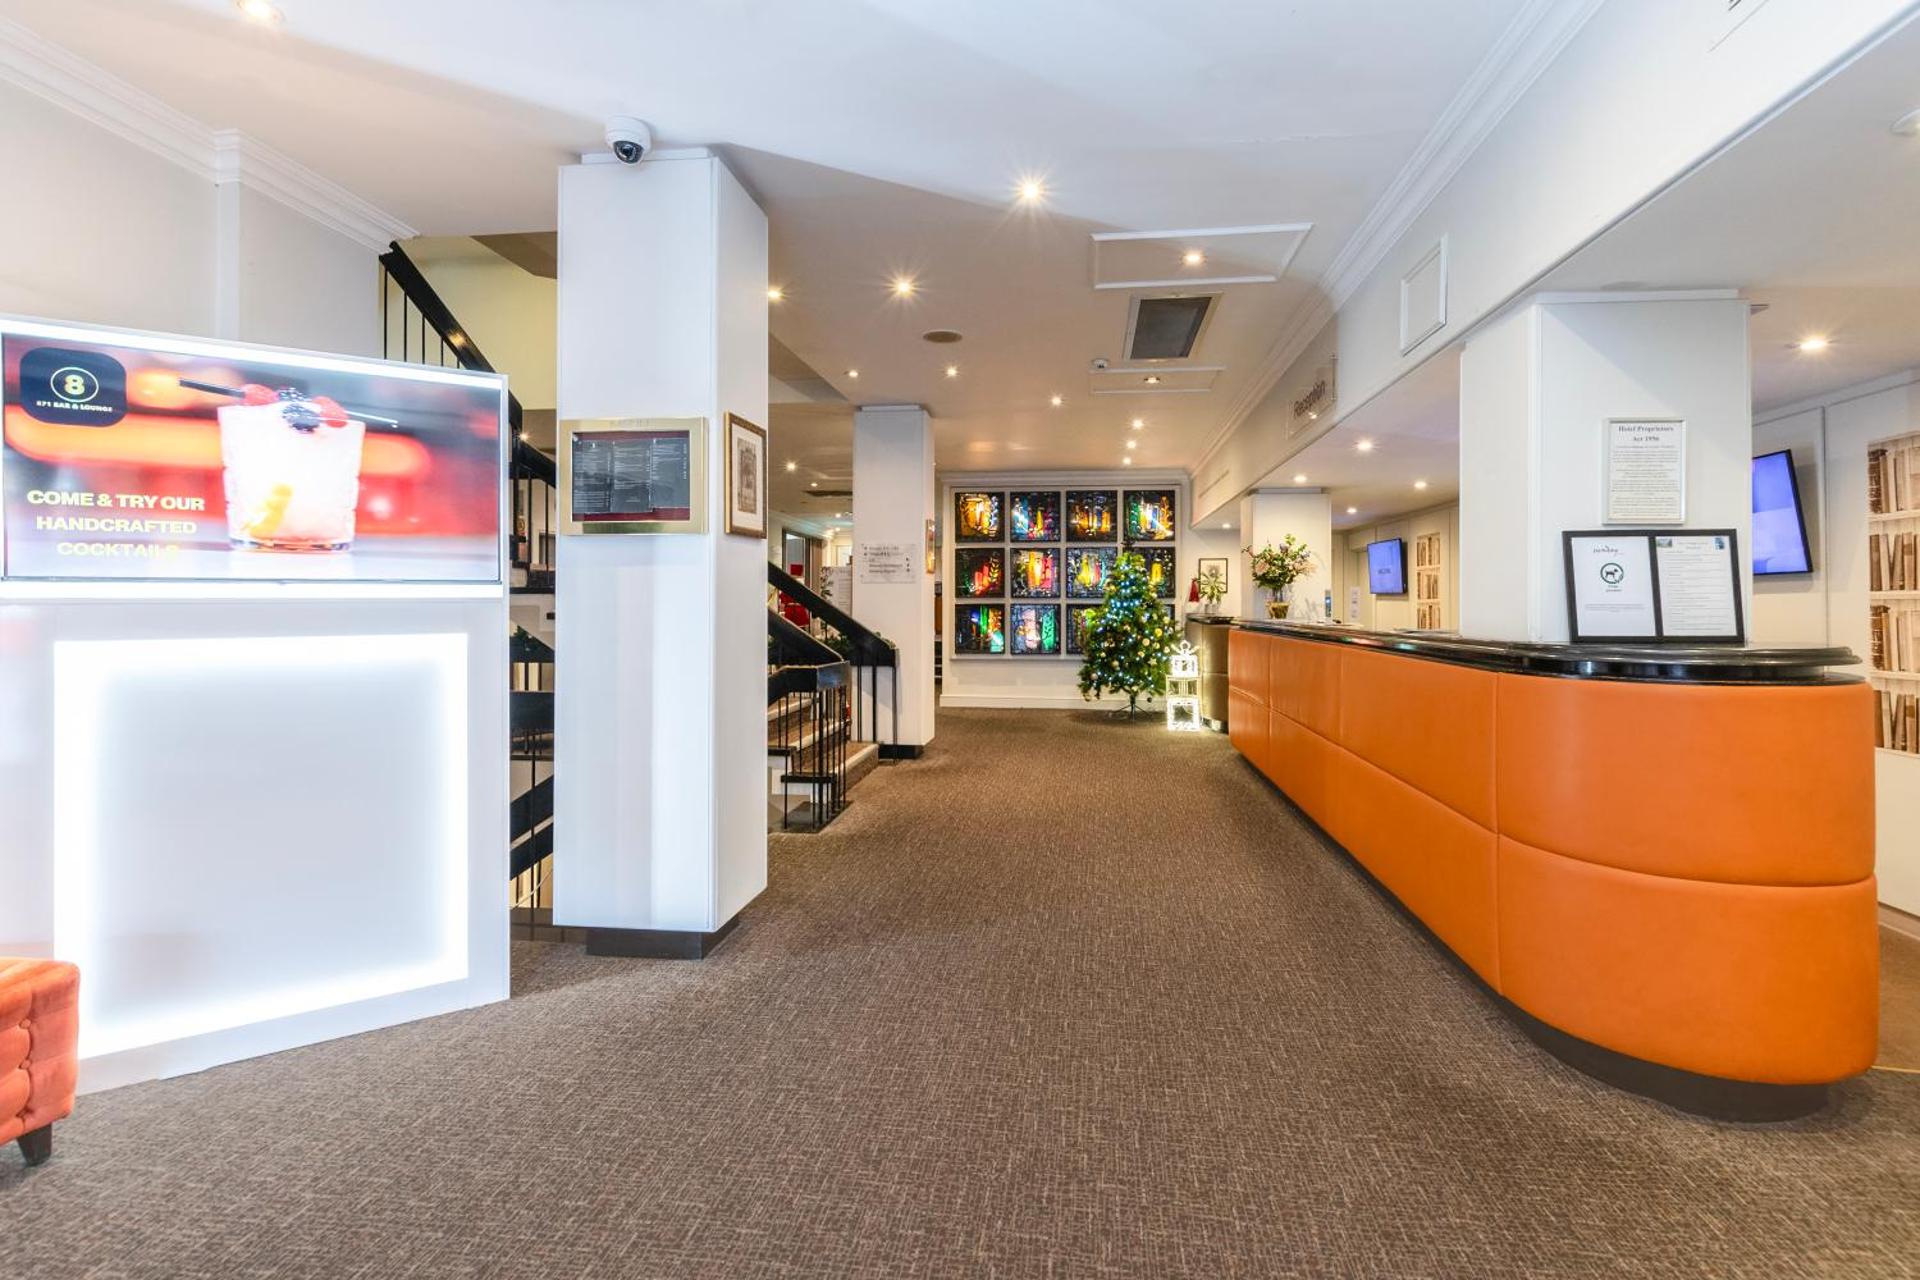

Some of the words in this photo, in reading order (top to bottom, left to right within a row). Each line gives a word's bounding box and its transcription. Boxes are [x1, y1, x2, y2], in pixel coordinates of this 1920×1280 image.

[64, 374, 85, 395] 8
[53, 402, 71, 410] BAR
[72, 403, 80, 411] &
[80, 403, 114, 413] LOUNGE
[27, 489, 95, 507] COME
[97, 492, 113, 508] &
[115, 493, 159, 510] TRY
[160, 496, 206, 512] OUR
[36, 515, 198, 534] HANDCRAFTED
